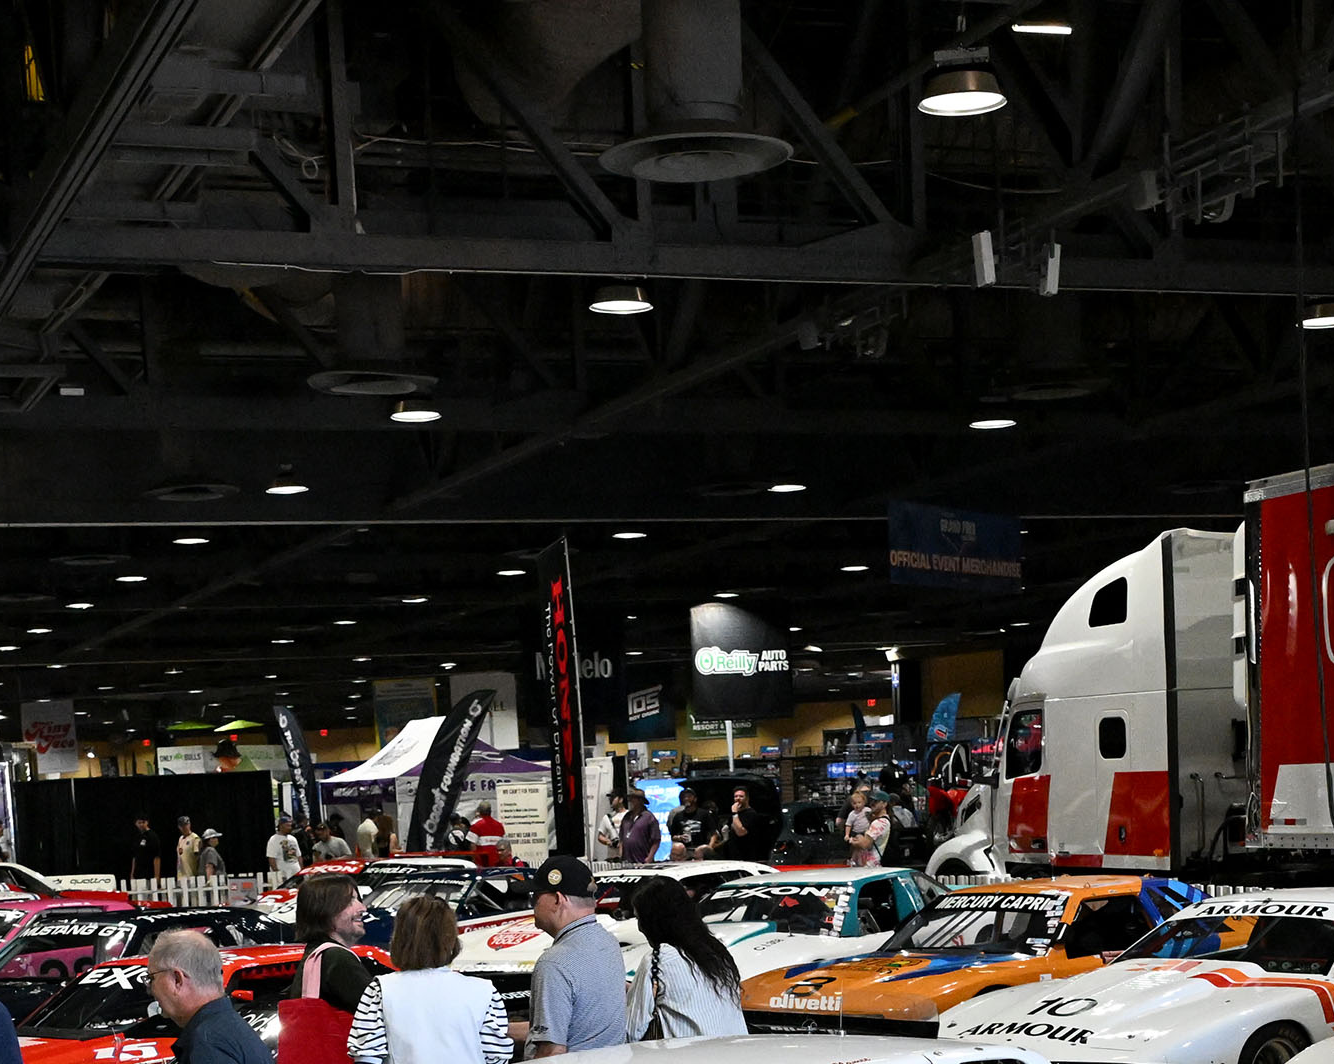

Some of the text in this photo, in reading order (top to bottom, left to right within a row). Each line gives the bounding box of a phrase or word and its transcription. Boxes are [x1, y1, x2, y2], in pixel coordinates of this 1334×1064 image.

[889, 550, 931, 569] OFFICIAL
[932, 553, 961, 572] EVENT
[761, 650, 787, 660] AUTO
[758, 661, 789, 672] PARTS
[440, 719, 473, 792] FOUNDATION
[69, 878, 112, 887] quattro
[710, 885, 830, 901] EXXON
[934, 894, 1055, 911] MERCURY CAPRI
[1195, 904, 1329, 918] ARMOUR
[20, 923, 131, 938] MUSTANG GT
[769, 995, 842, 1012] olivetti
[1026, 997, 1098, 1017] 10
[958, 1022, 1095, 1045] ARMOUR
[93, 1042, 158, 1062] 15
